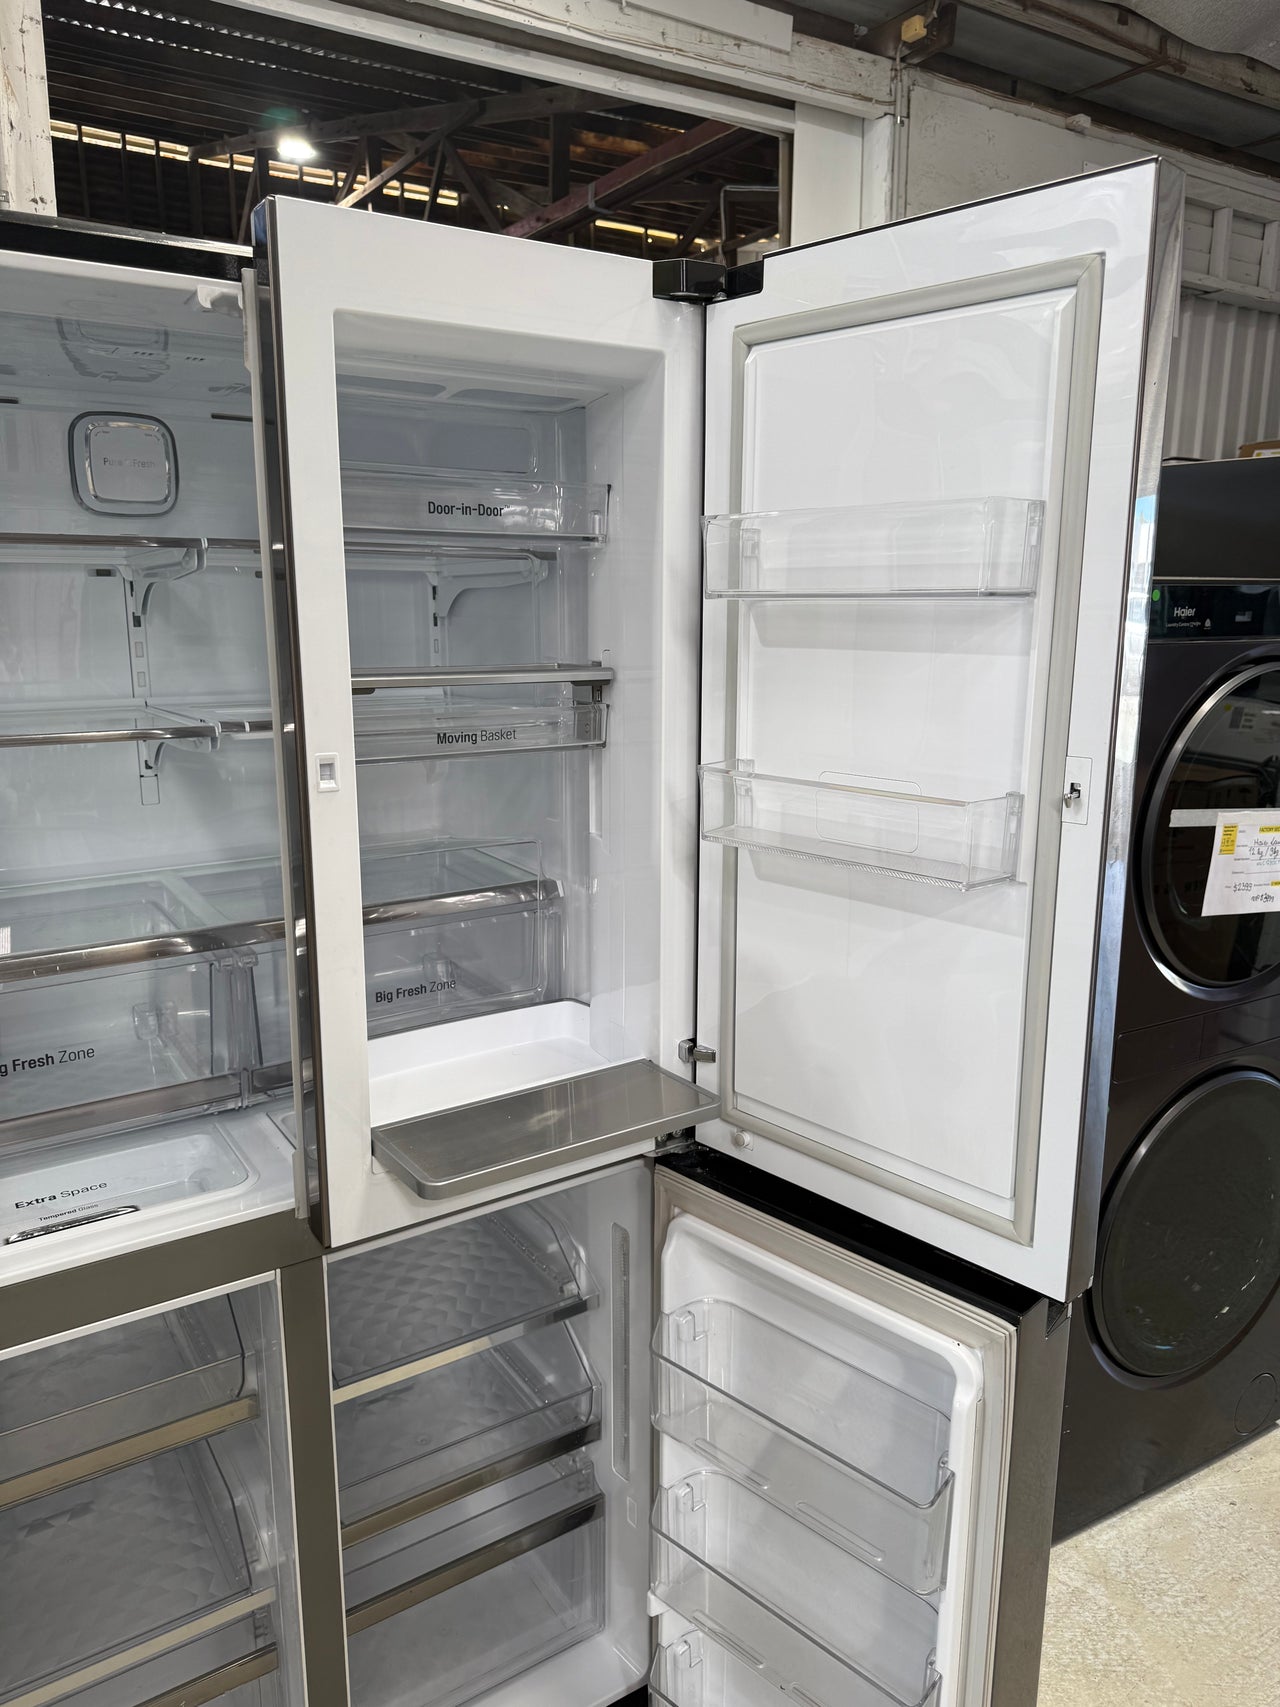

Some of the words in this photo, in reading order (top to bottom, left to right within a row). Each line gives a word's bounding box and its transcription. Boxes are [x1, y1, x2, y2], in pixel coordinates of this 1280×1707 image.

[1173, 606, 1196, 617] Haier
[437, 731, 477, 745] Moving
[480, 729, 517, 742] Basket
[375, 991, 393, 1003] Big
[396, 984, 427, 999] Fresh
[429, 980, 456, 993] Zone
[12, 1053, 55, 1072] Fresh
[58, 1047, 95, 1063] Zone
[15, 1195, 57, 1209] Extra
[60, 1182, 108, 1197] Space
[39, 1209, 77, 1221] Tempered
